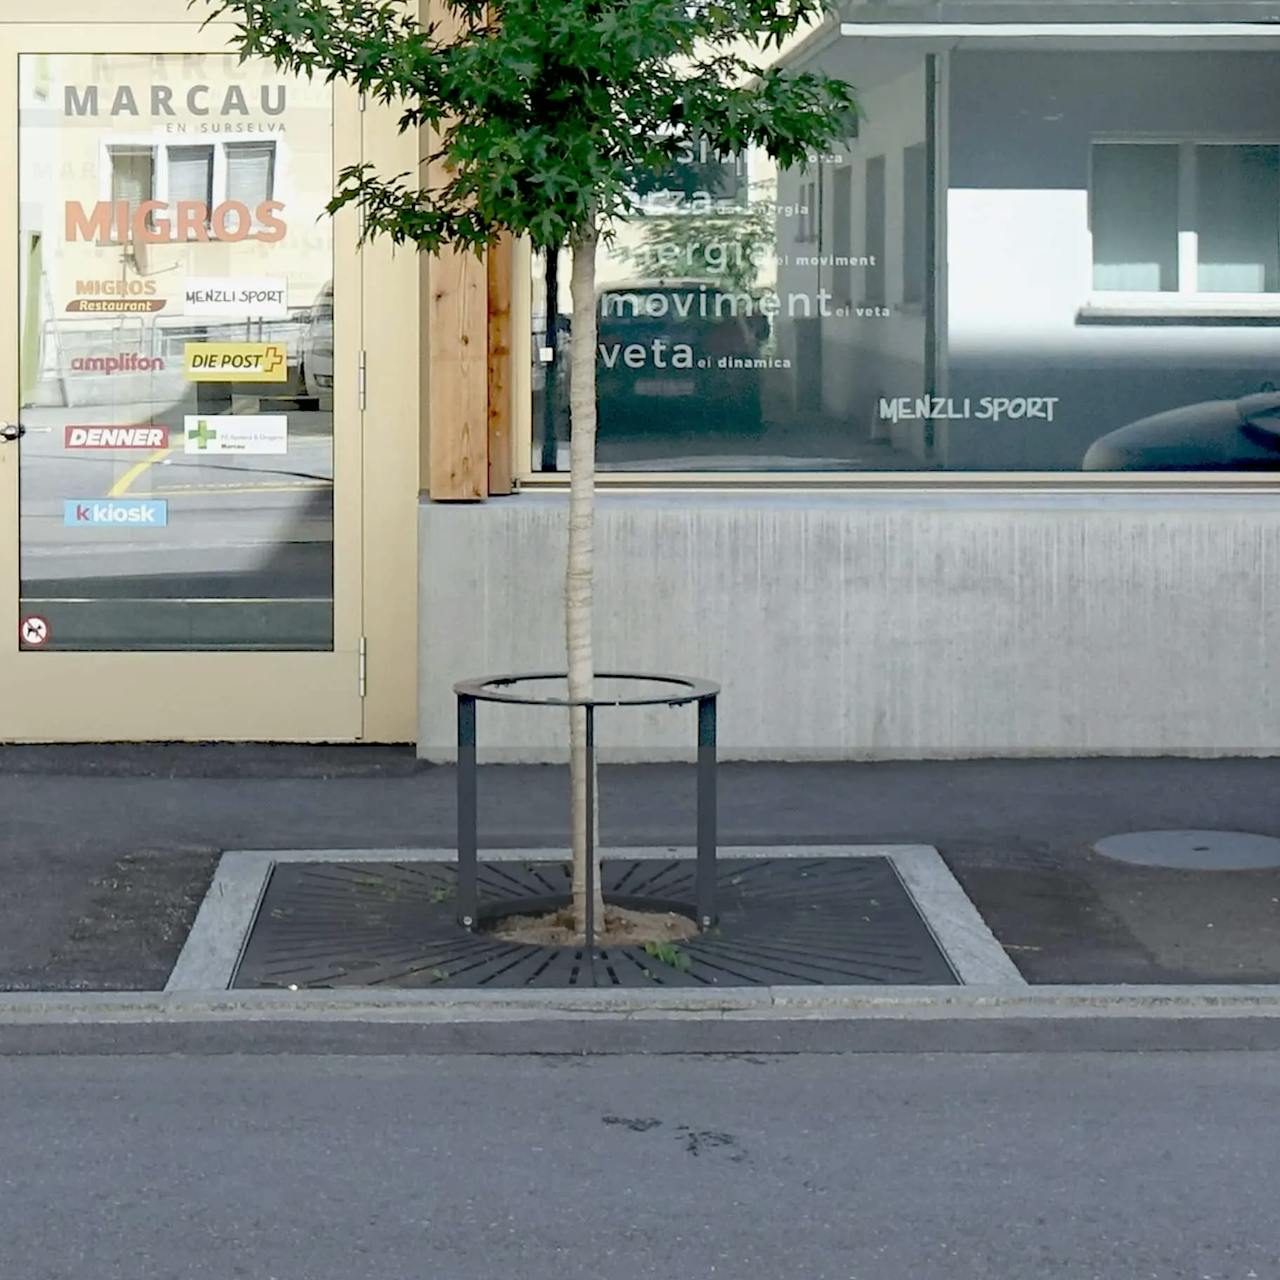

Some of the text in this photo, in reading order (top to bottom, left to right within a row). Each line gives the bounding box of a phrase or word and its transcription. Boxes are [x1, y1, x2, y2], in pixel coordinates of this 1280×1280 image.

[63, 84, 287, 117] MARCAU
[166, 122, 287, 134] EN SURSELVA
[63, 199, 288, 244] MIGROS
[795, 253, 876, 267] moviment
[75, 279, 157, 296] MIGROS
[185, 288, 285, 305] MENZLI SPORT
[80, 300, 153, 312] Restaurant
[600, 284, 833, 318] moviment
[856, 305, 891, 317] veta
[192, 354, 264, 369] DIE POST
[598, 337, 694, 369] veta
[717, 355, 792, 369] dinamica
[71, 351, 166, 376] amplifon
[879, 393, 1060, 424] MENZLI SPORT
[69, 428, 164, 447] DENNER
[76, 503, 156, 522] k kiosk
